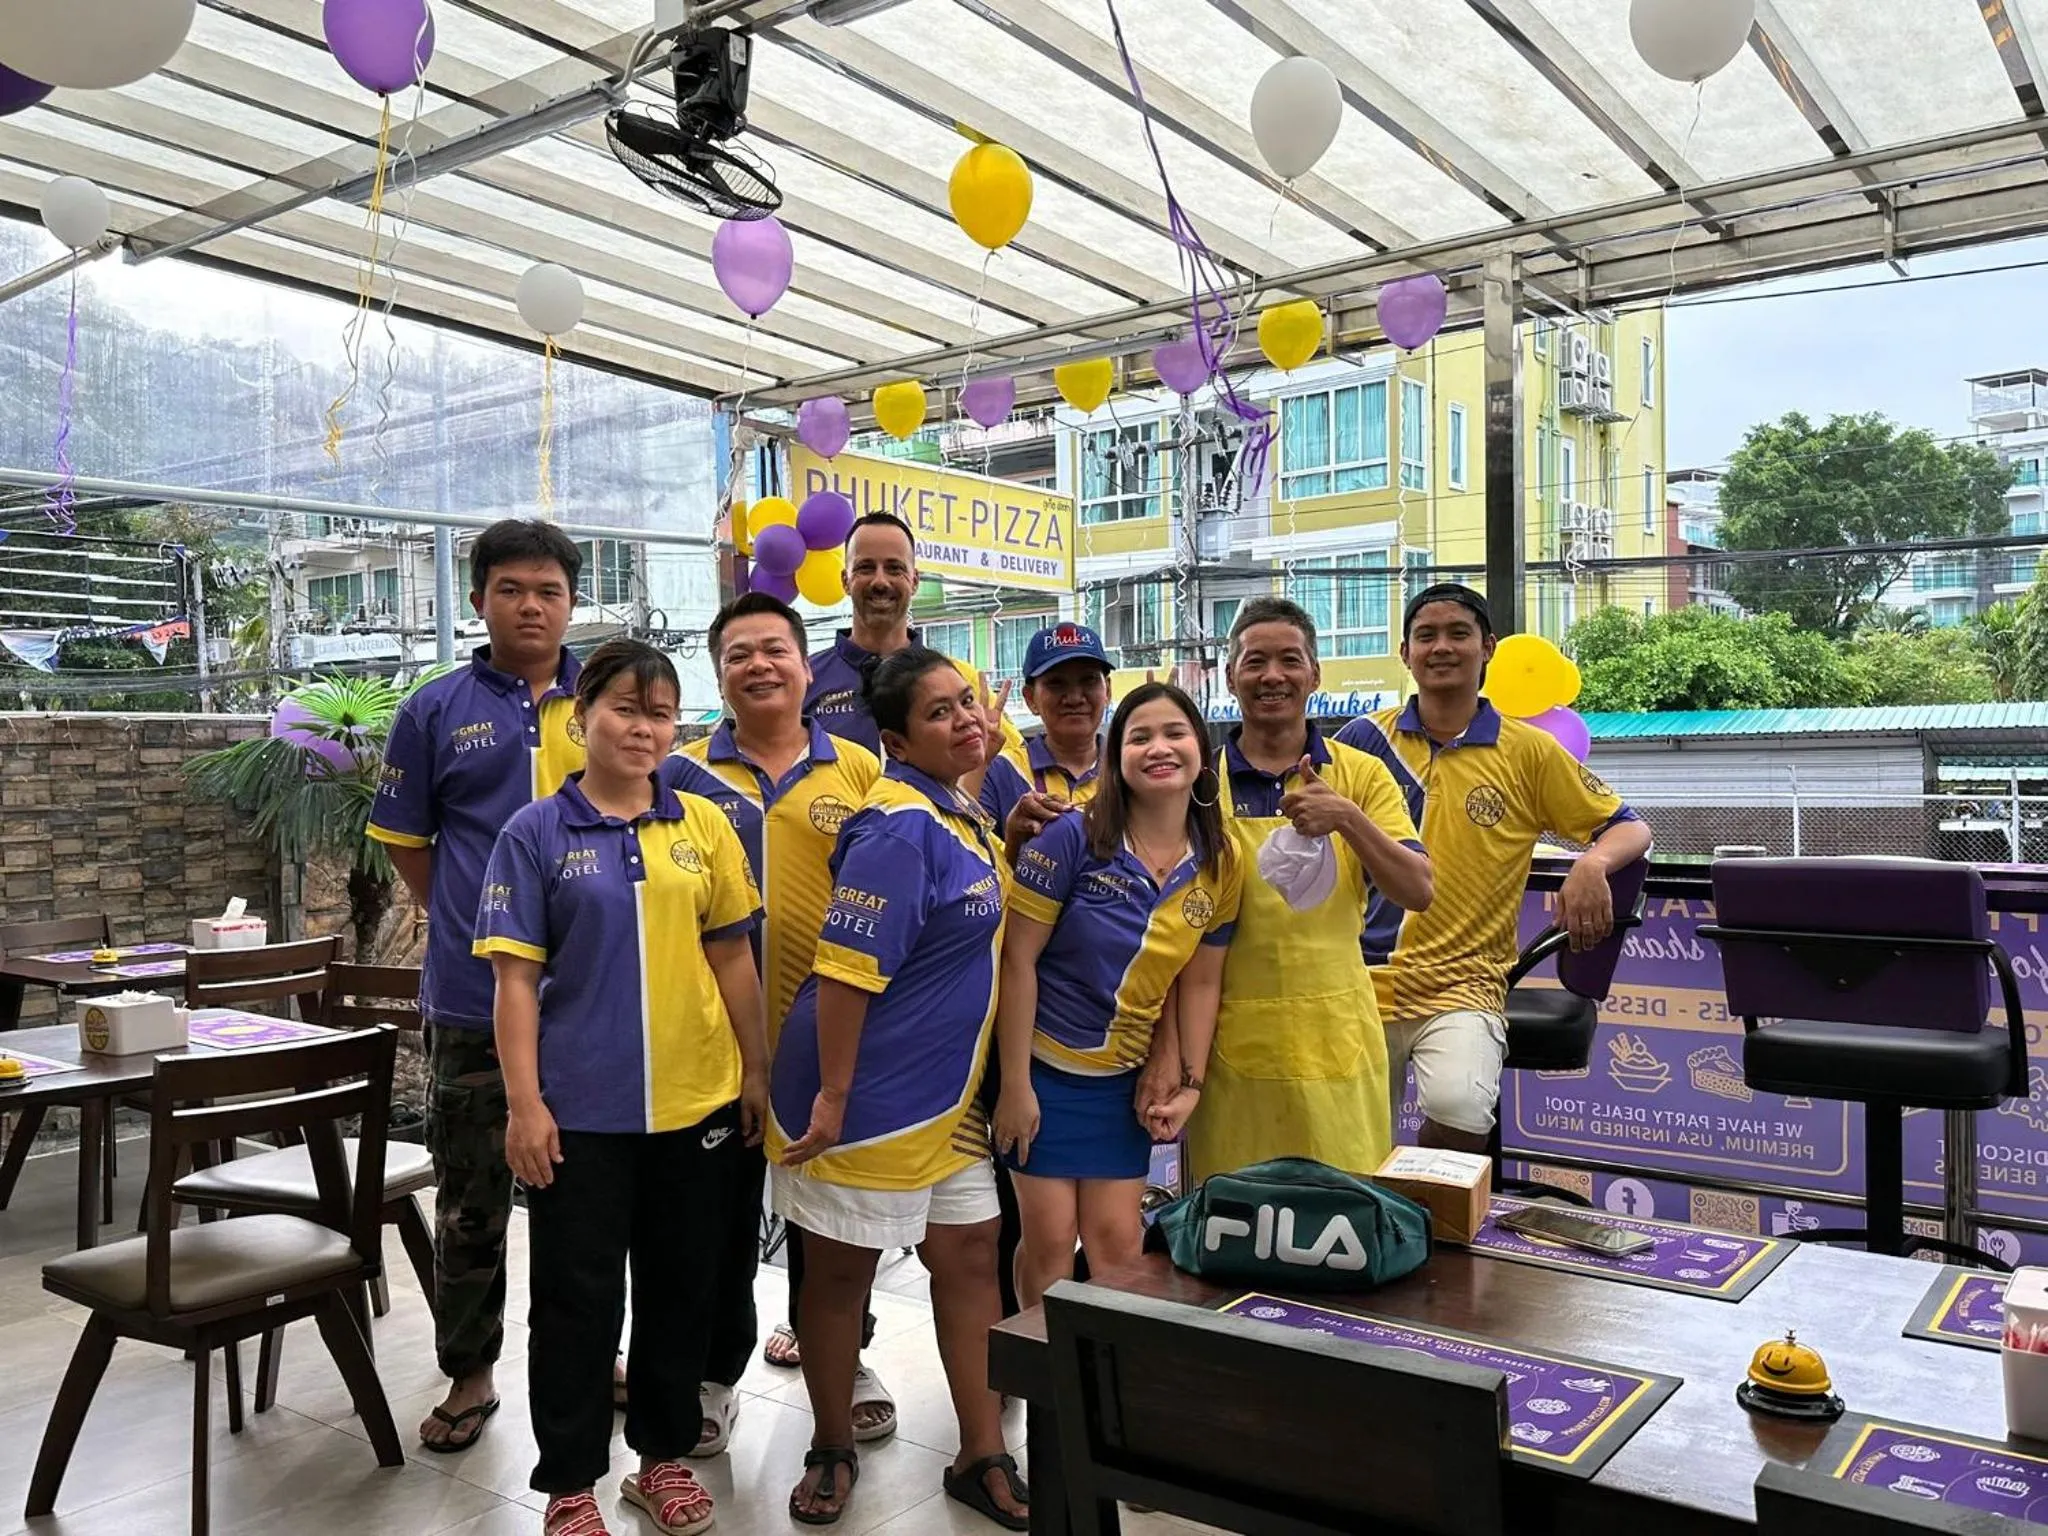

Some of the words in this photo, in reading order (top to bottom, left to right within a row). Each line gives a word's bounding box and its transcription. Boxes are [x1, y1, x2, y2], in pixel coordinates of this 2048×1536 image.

[806, 467, 1063, 551] PHUKET-PIZZA
[915, 544, 968, 565] AURANT
[980, 551, 990, 567] &
[1001, 553, 1058, 576] DELIVERY
[825, 690, 854, 702] GREAT
[1306, 690, 1382, 715] Phuket
[816, 705, 855, 715] HOTEL
[459, 721, 494, 737] GREAT
[454, 736, 497, 755] HOTEL
[813, 814, 839, 824] PIZZ
[567, 849, 599, 860] REAT
[1026, 848, 1059, 872] GREAT
[1016, 863, 1052, 890] HOTEL
[837, 885, 889, 911] GREAT
[964, 899, 1002, 917] HOTE
[824, 907, 876, 939] HOTEL
[1204, 1203, 1368, 1271] FILA
[1313, 1316, 1344, 1328] PIZZA
[1434, 1337, 1490, 1355] DELIVERY
[1980, 1458, 2025, 1474] PIZZA
